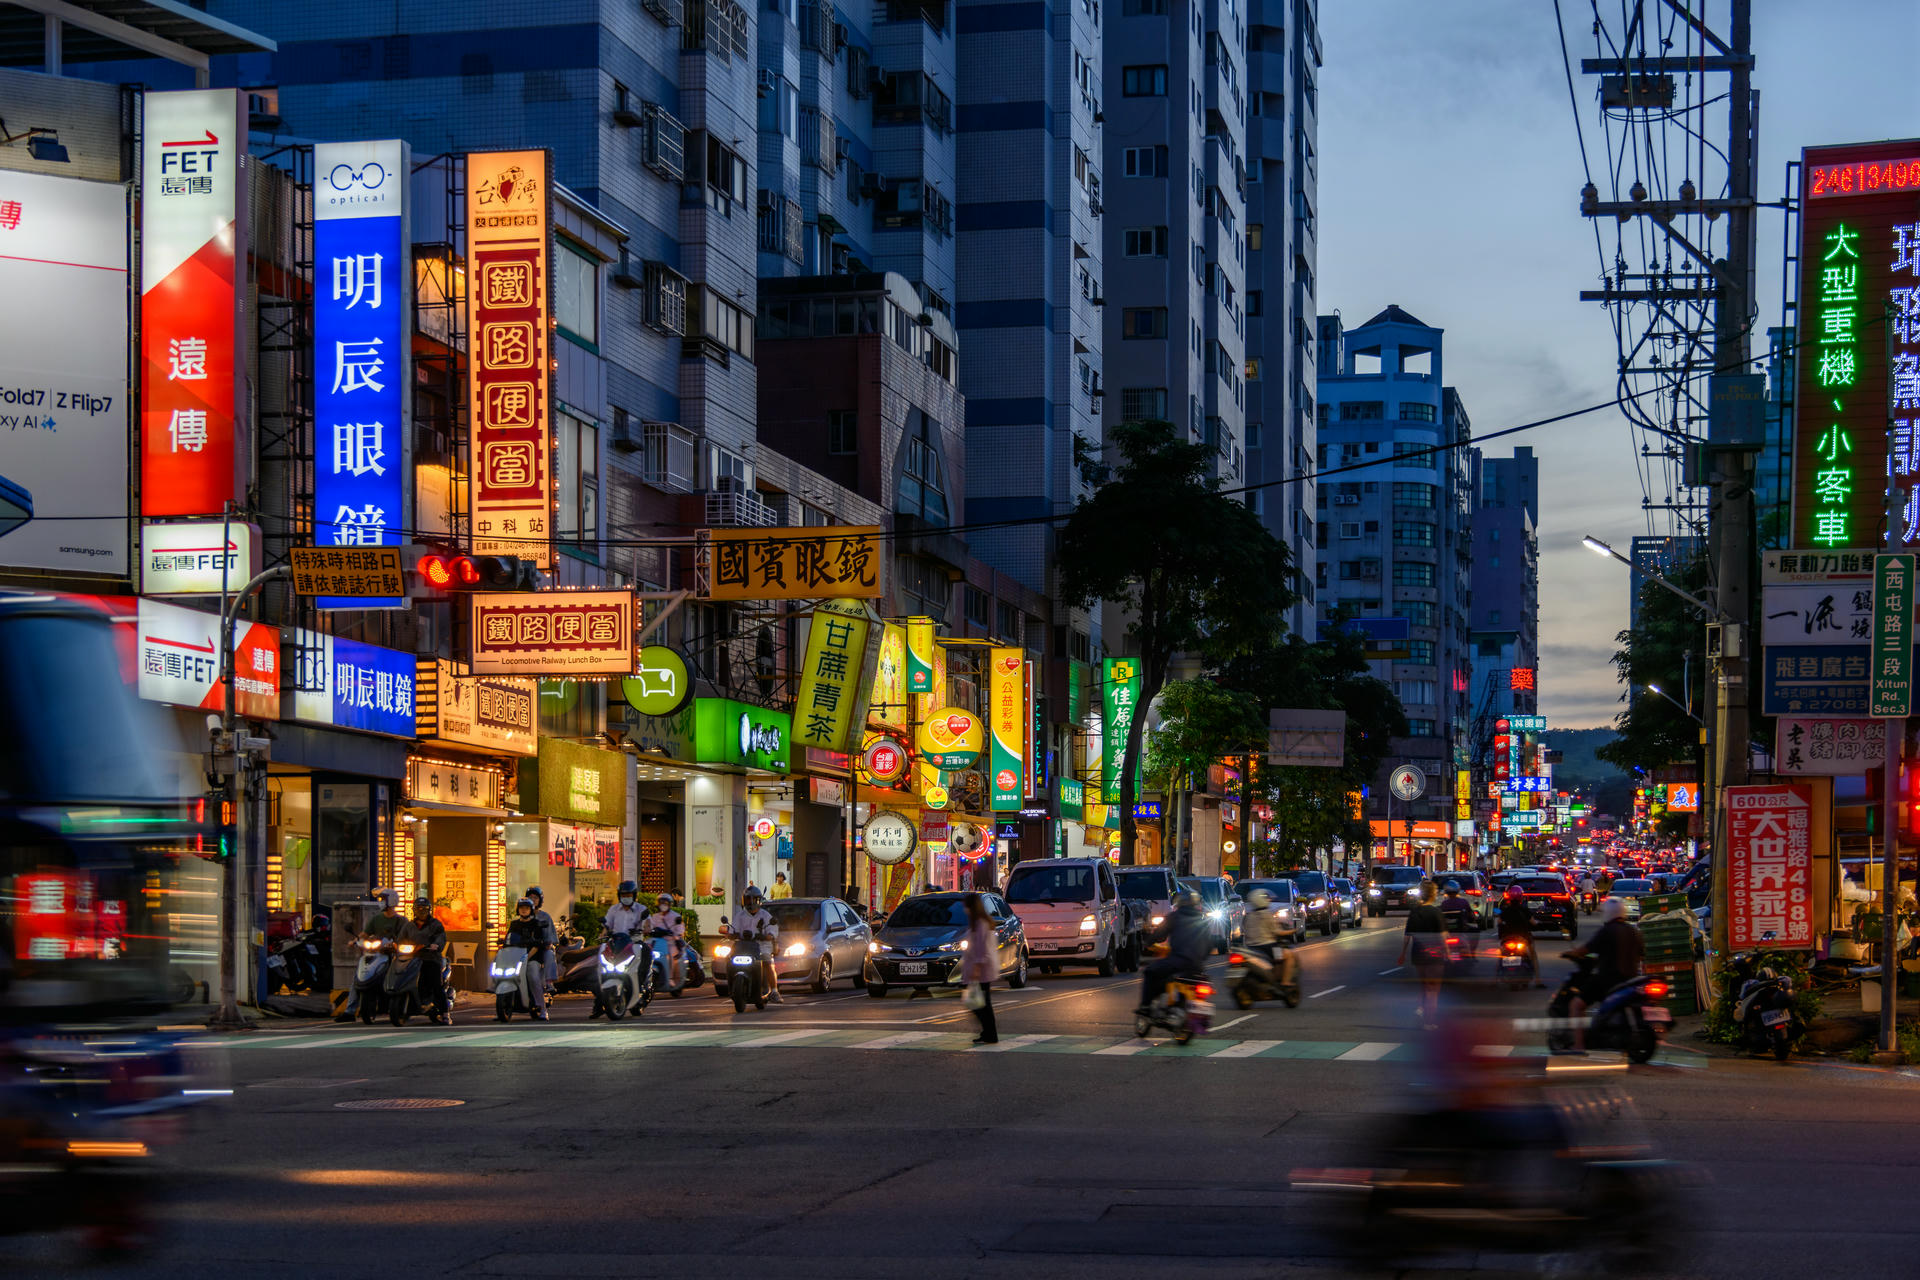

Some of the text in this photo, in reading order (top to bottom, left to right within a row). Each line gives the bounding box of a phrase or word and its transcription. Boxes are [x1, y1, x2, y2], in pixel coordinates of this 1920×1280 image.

[162, 151, 218, 173] FET
[162, 176, 212, 196] 遠傳
[330, 194, 385, 205] optical
[489, 265, 529, 482] 鐵路便當
[1814, 223, 1859, 546] 大型重機、小客車
[56, 392, 67, 408] Z
[71, 393, 112, 417] Flip7
[168, 337, 208, 453] 遠傳
[331, 252, 386, 545] 明辰眼鏡
[23, 415, 38, 429] AI
[478, 517, 543, 534] 中科站
[59, 545, 113, 557] samsung.com
[295, 551, 396, 571] 特殊時相路口
[717, 536, 875, 590] 國賓眼鏡
[297, 573, 400, 595] 請依號誌行駛
[1767, 594, 1842, 634] 一流
[1882, 571, 1904, 676] 西屯路三段
[488, 616, 613, 641] 鐵路便當
[184, 655, 215, 683] FET
[502, 657, 540, 665] Locomotive
[541, 657, 566, 665] Railway
[568, 656, 588, 664] Lunch
[337, 662, 412, 717] 明辰眼鏡
[804, 619, 855, 743] 甘蔗青茶
[1875, 679, 1908, 689] Xitun
[1001, 681, 1014, 733] 公益彩券
[1881, 692, 1900, 701] Rd.
[1874, 705, 1906, 714] Sec.3
[431, 771, 478, 798] 中科站
[1737, 795, 1789, 808] 600公尺
[873, 827, 902, 838] 可不可
[1750, 811, 1786, 941] 大世界家具
[1788, 809, 1809, 941] 福雅路488號
